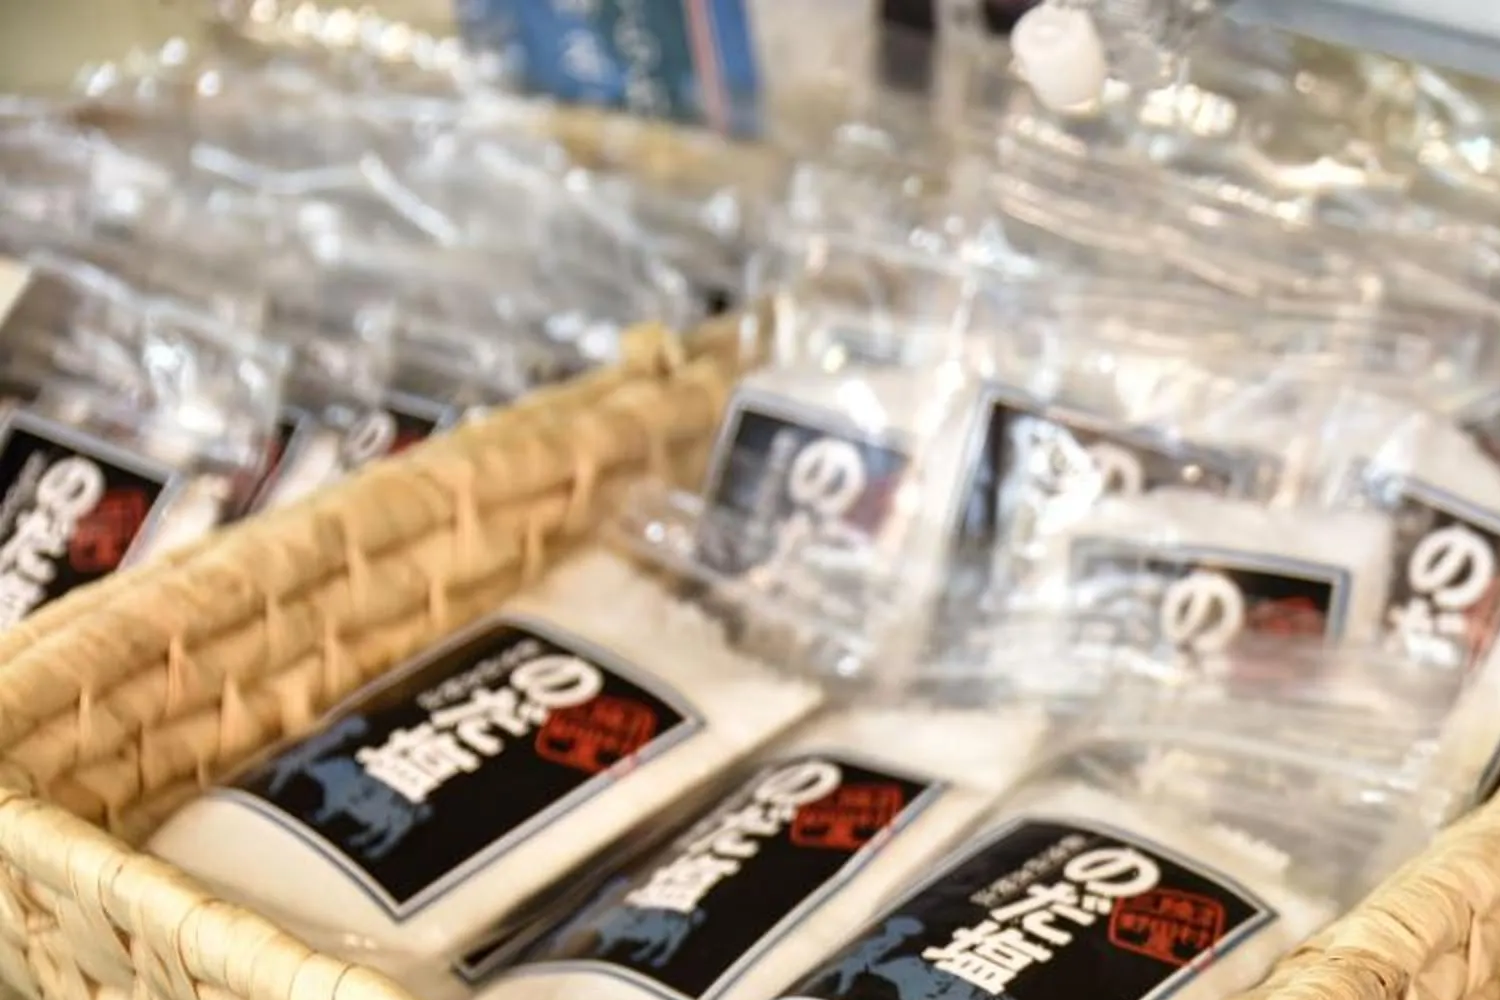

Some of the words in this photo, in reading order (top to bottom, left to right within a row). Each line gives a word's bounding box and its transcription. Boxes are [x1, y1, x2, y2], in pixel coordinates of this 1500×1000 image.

[355, 655, 603, 801] のだ塩
[923, 849, 1161, 995] のだ塩
